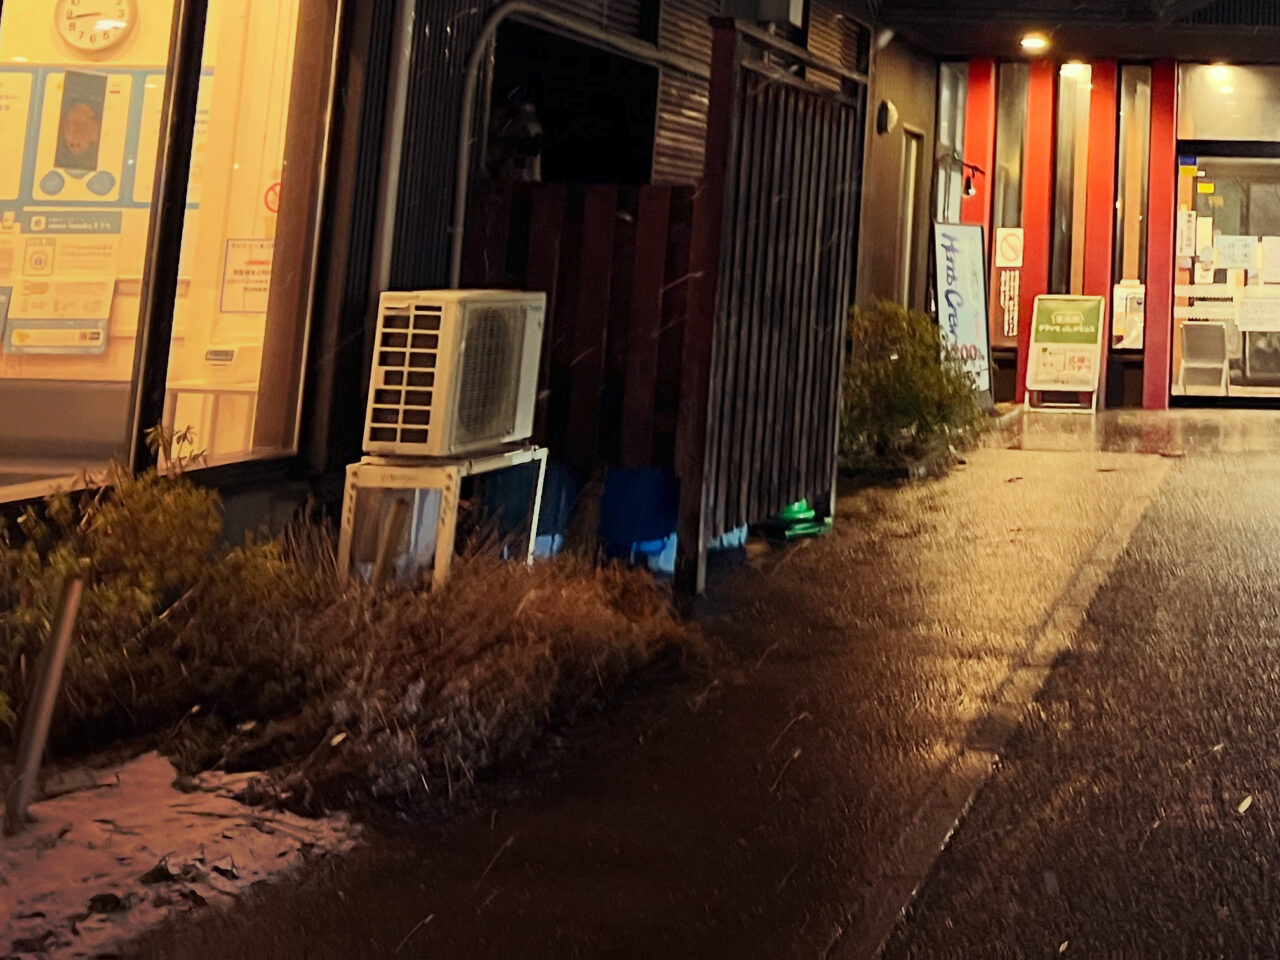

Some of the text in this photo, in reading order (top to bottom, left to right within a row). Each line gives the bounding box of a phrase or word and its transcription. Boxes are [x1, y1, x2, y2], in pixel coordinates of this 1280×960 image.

[118, 9, 124, 18] 3
[78, 31, 85, 39] 7
[89, 33, 96, 44] 6
